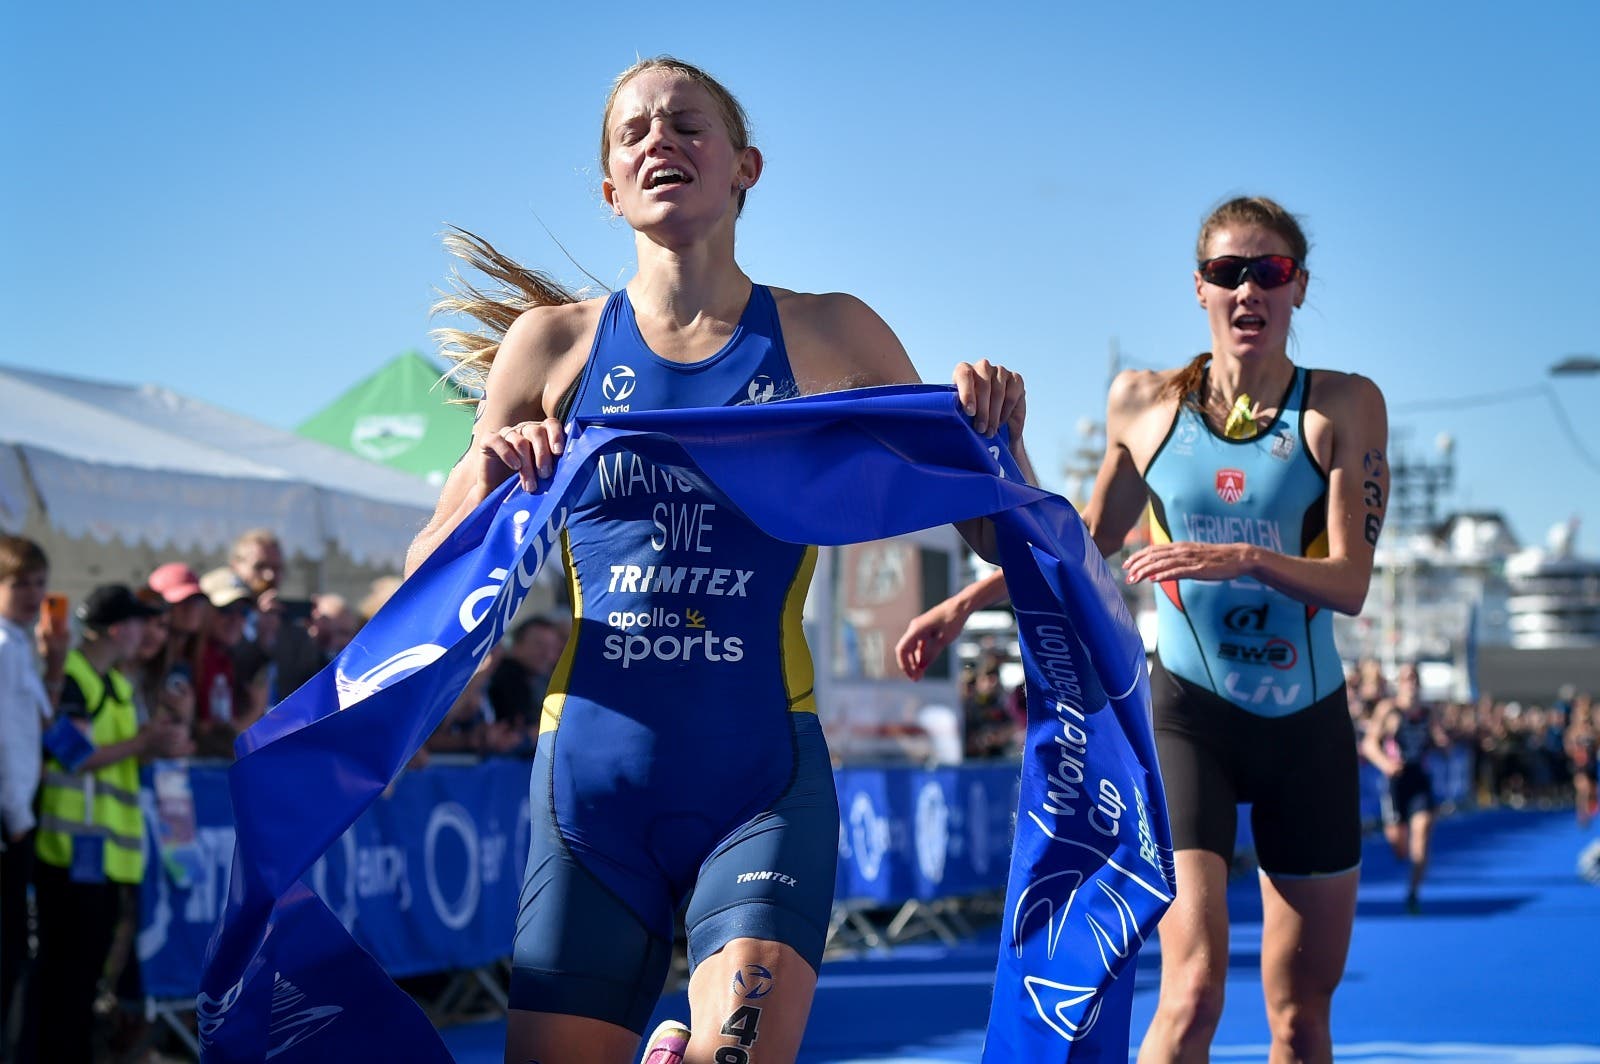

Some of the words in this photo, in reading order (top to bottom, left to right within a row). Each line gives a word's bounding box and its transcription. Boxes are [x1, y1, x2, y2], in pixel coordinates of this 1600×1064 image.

[602, 404, 630, 414] World
[651, 502, 716, 552] SWE
[608, 565, 754, 598] TRIMTEX
[608, 607, 680, 631] apollo
[602, 630, 744, 669] sports
[1224, 671, 1300, 706] Liv
[1042, 722, 1087, 816] World
[1087, 778, 1127, 837] Cup
[736, 871, 798, 888] TRIMTEX
